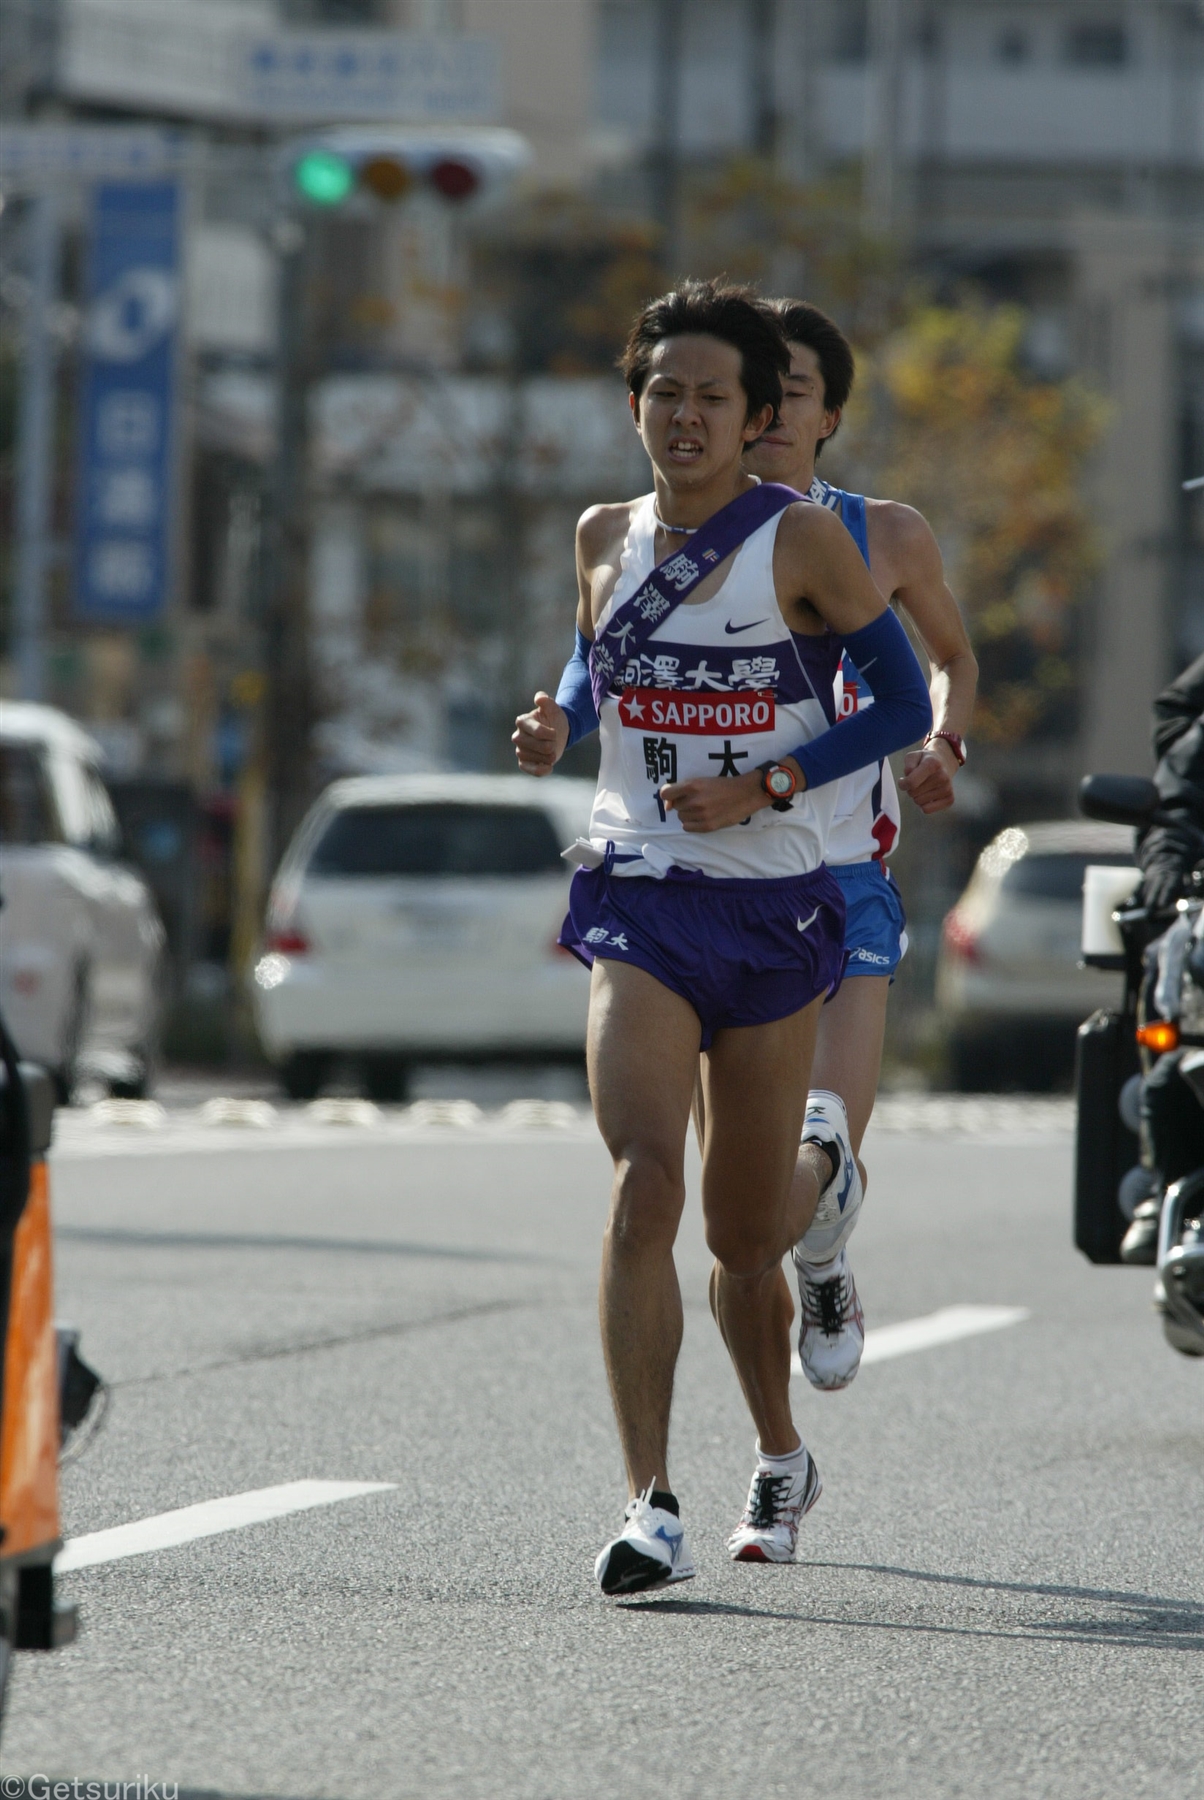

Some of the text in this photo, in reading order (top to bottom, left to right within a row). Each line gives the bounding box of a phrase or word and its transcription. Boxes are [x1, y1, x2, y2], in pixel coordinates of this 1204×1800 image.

[651, 700, 770, 728] SAPPORO
[582, 927, 629, 951] 駒大
[857, 948, 890, 966] asics
